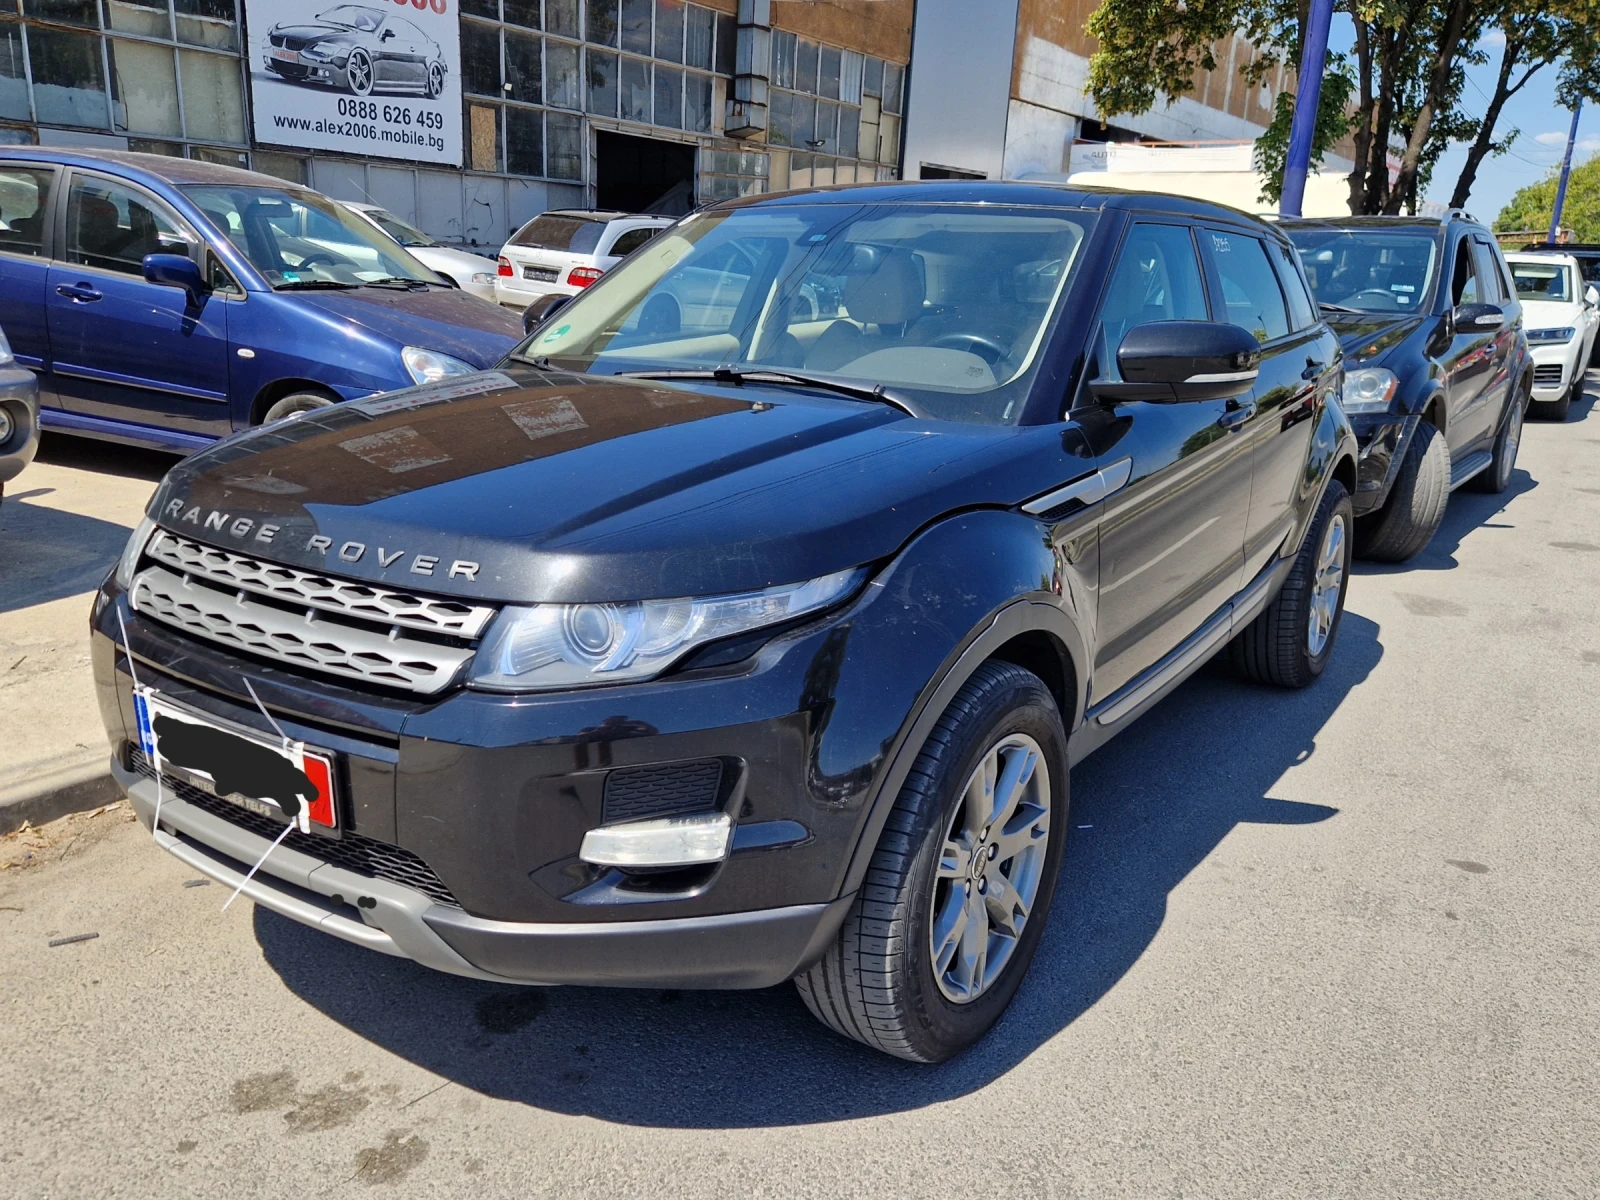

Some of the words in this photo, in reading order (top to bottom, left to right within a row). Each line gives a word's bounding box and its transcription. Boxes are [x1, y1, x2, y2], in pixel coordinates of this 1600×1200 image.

[337, 97, 378, 121] 0888
[383, 105, 412, 126] 626
[416, 110, 443, 130] 459
[273, 115, 444, 152] www.alex2006.mobile.bg
[164, 497, 281, 544] RANGE
[304, 533, 481, 582] ROVER
